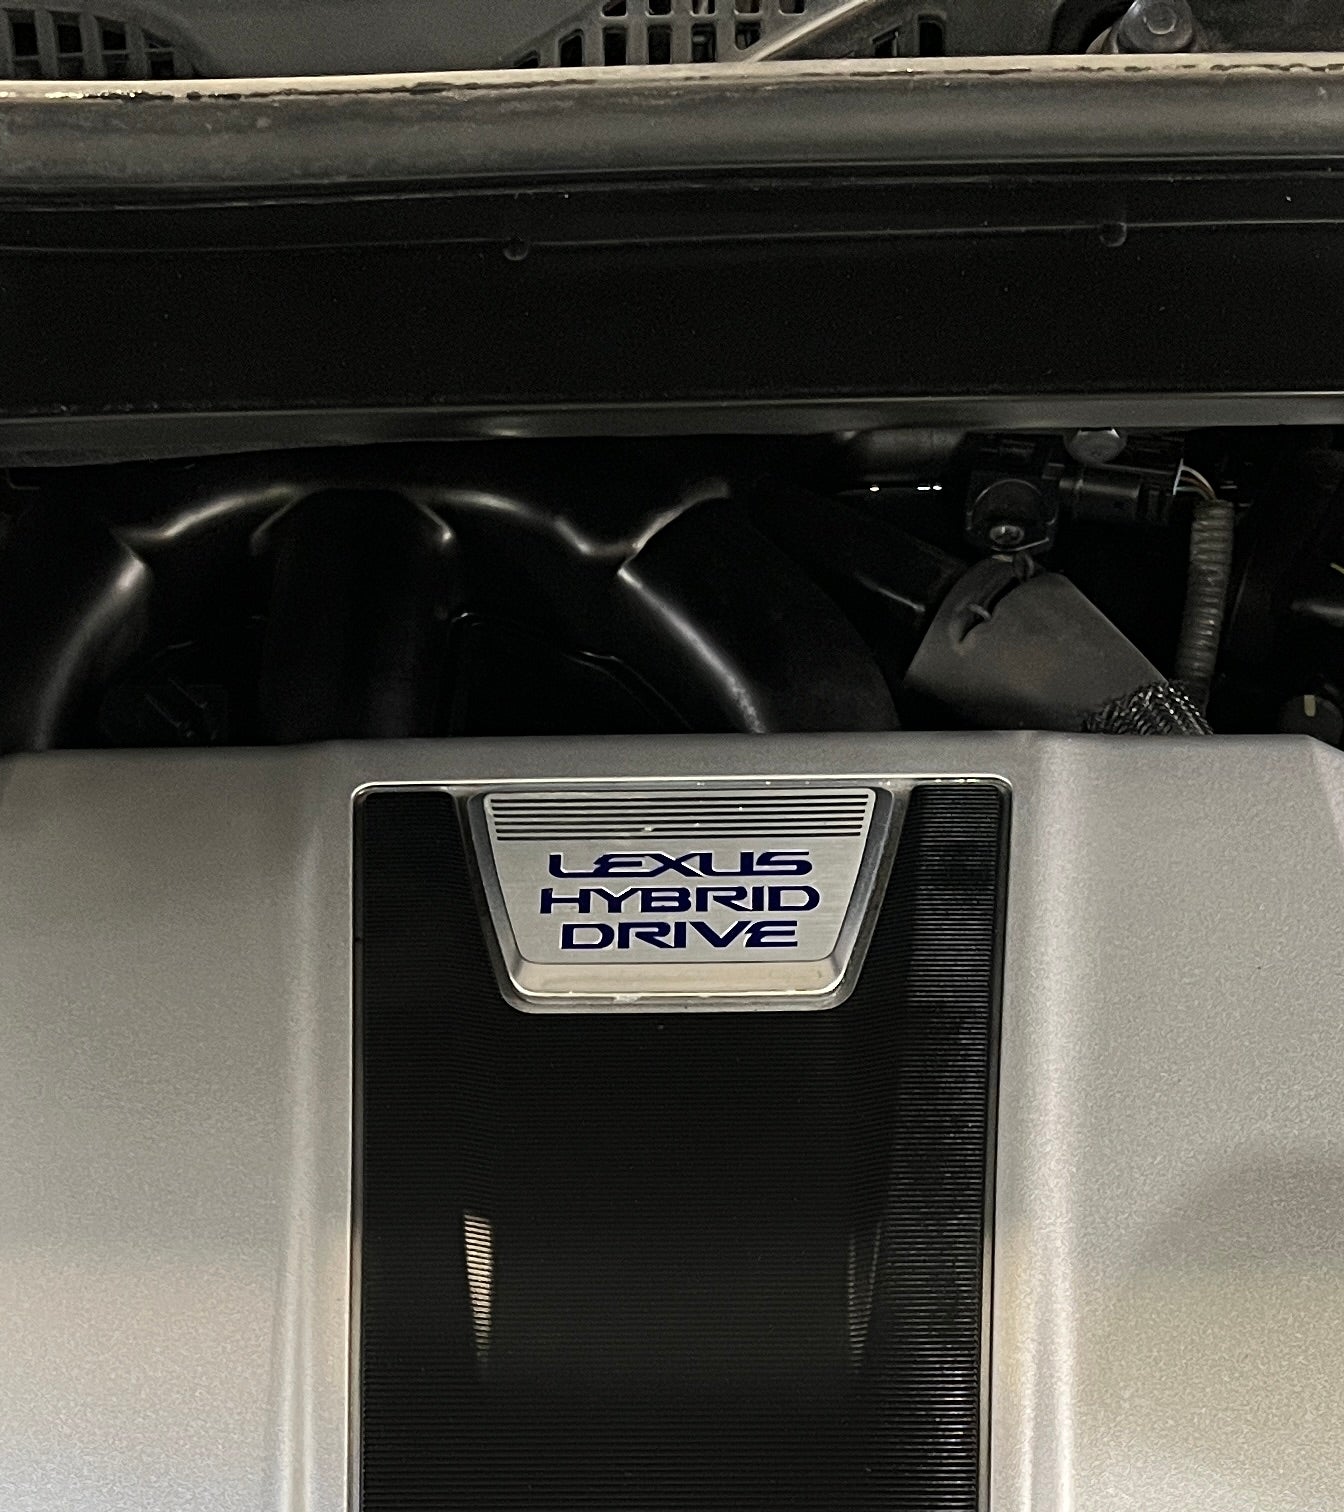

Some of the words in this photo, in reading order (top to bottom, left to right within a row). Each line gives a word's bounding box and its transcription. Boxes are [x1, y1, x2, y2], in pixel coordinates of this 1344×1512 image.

[548, 850, 813, 879] LEXUS
[539, 885, 821, 914] HYBRID
[560, 920, 798, 949] DRIVE
